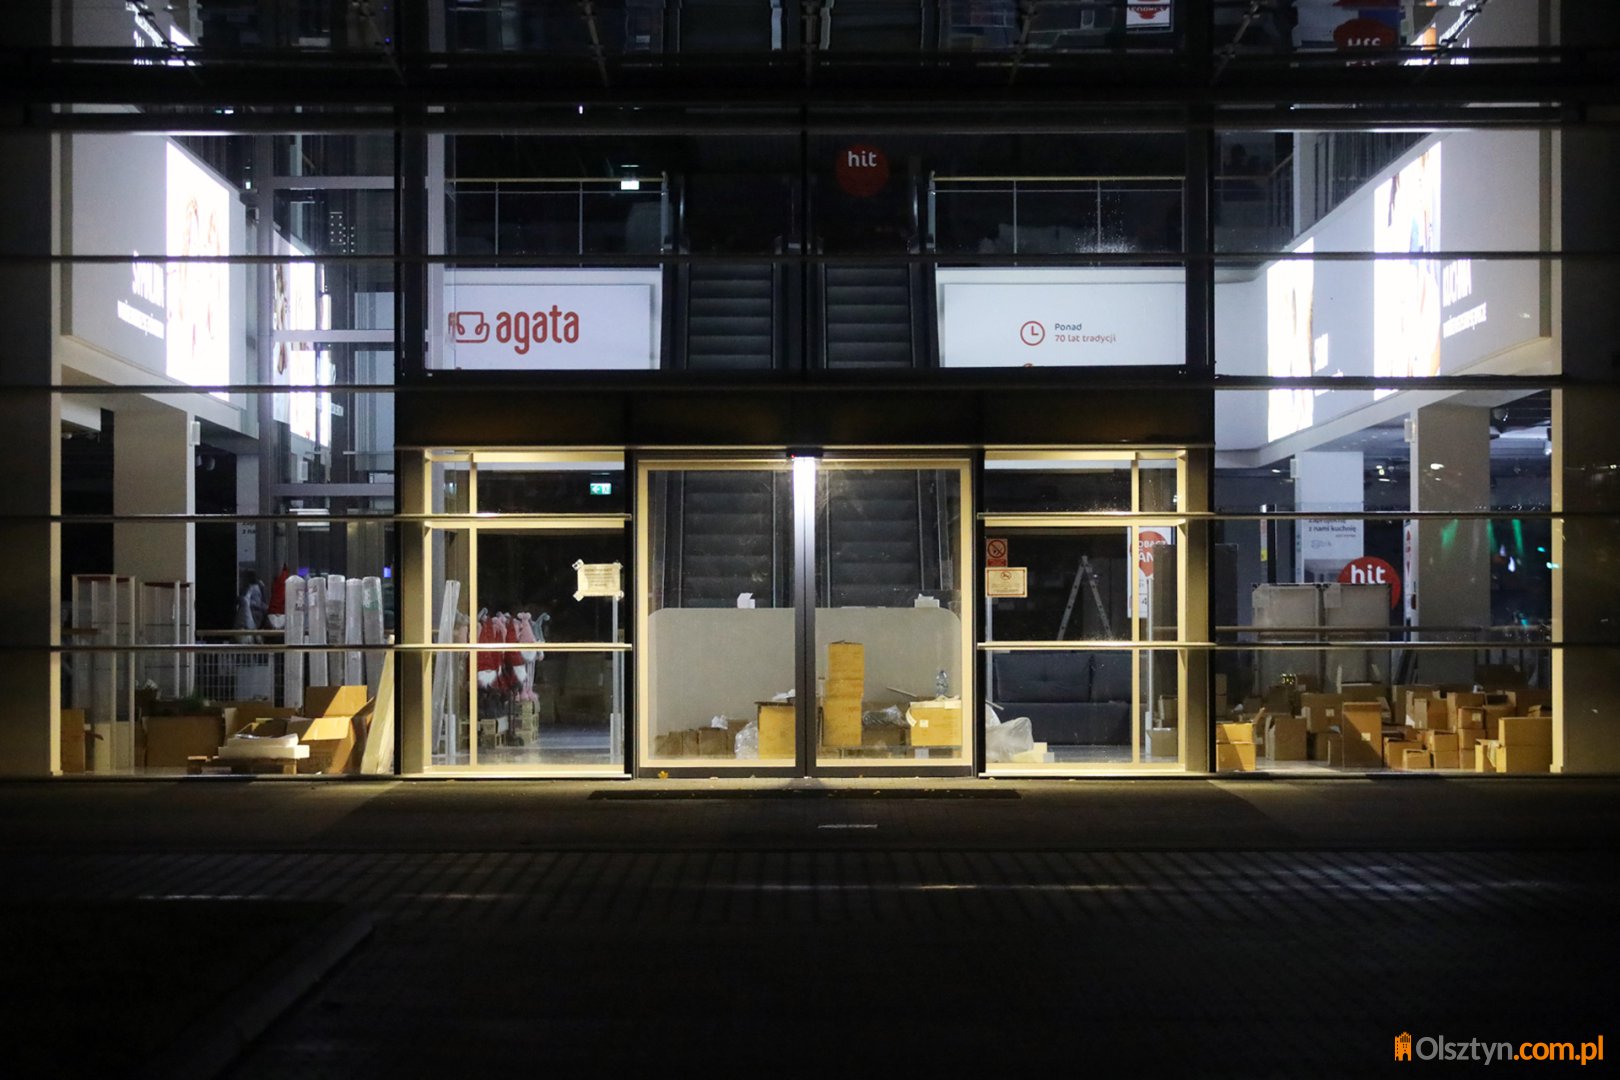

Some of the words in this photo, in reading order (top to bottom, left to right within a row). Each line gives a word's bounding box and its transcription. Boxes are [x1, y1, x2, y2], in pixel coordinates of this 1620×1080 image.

[848, 150, 877, 167] hit
[496, 304, 580, 355] agata
[1054, 323, 1082, 331] Ponad
[1054, 334, 1066, 342] 70
[1068, 334, 1080, 342] lat
[1082, 334, 1117, 344] tradycji
[1351, 564, 1386, 584] hit
